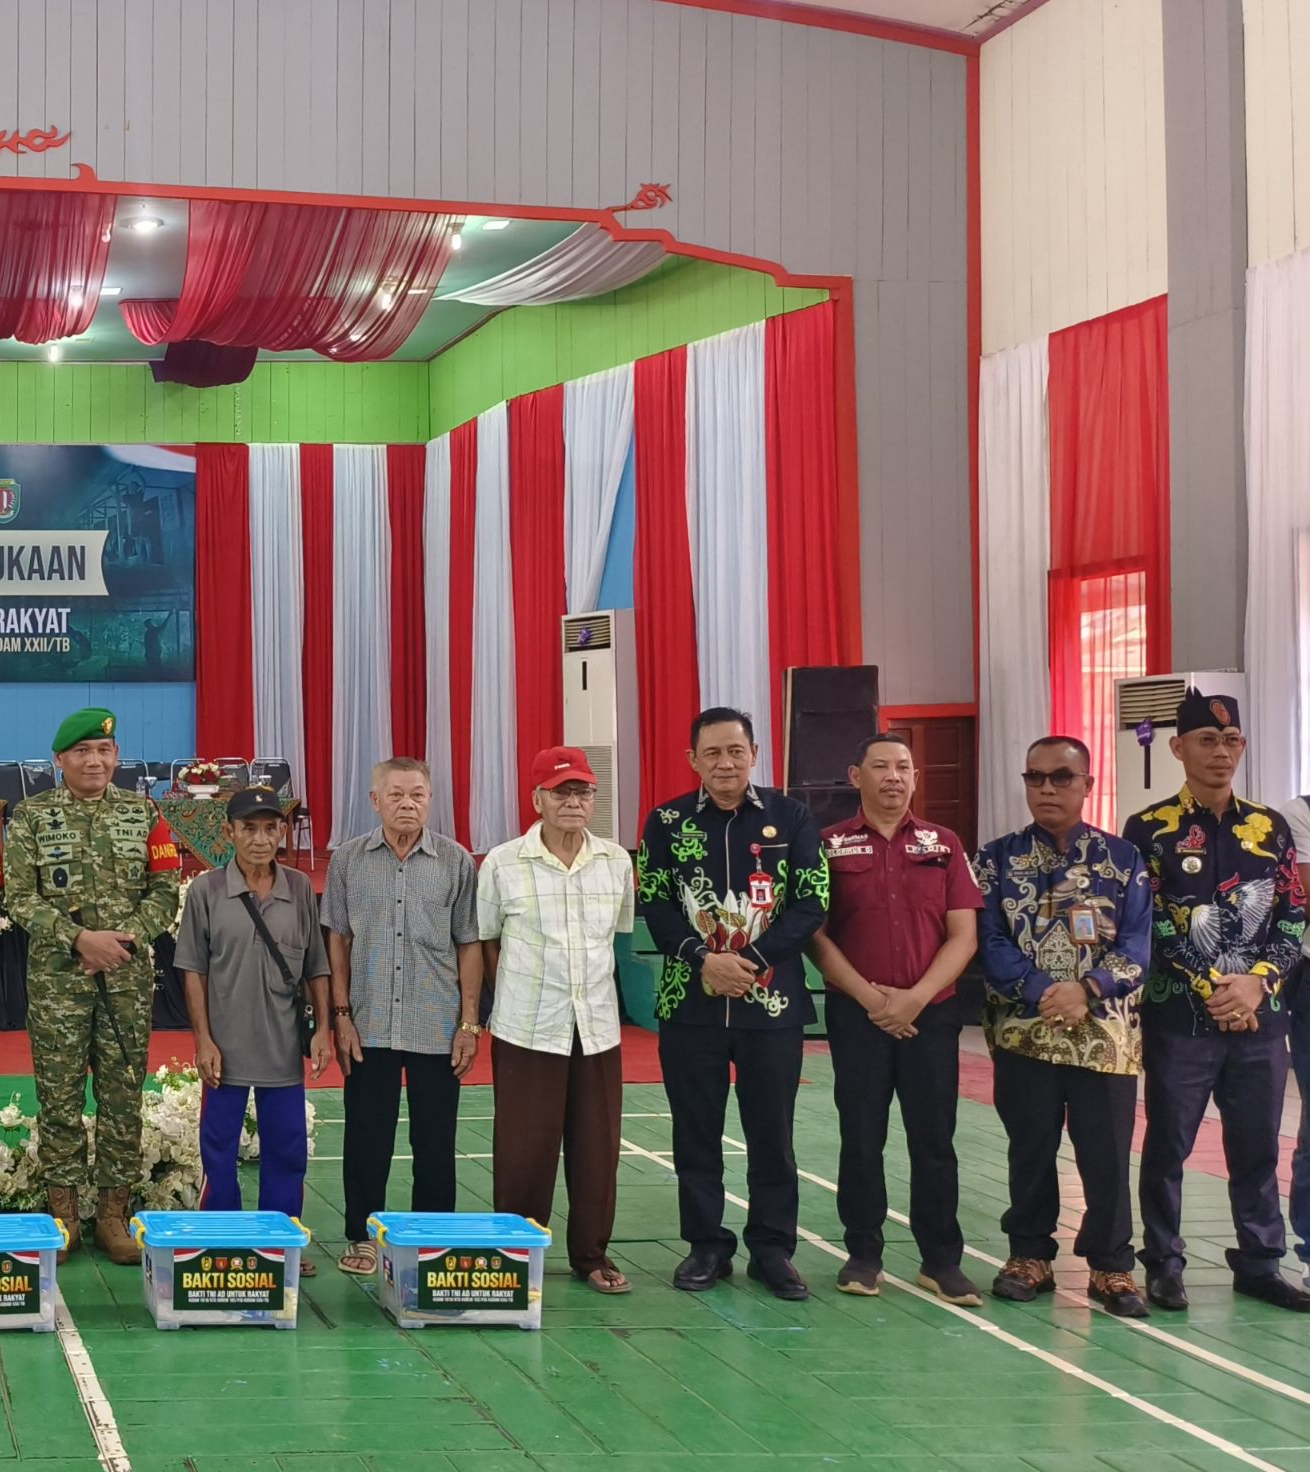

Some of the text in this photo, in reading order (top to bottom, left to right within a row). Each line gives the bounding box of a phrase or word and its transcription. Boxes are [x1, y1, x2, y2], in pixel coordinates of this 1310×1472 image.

[24, 637, 71, 652] XXII/TB
[115, 829, 133, 837] TNI
[183, 1272, 276, 1288] BAKTI SOSIAL
[427, 1272, 521, 1288] BAKTI SOSIAL
